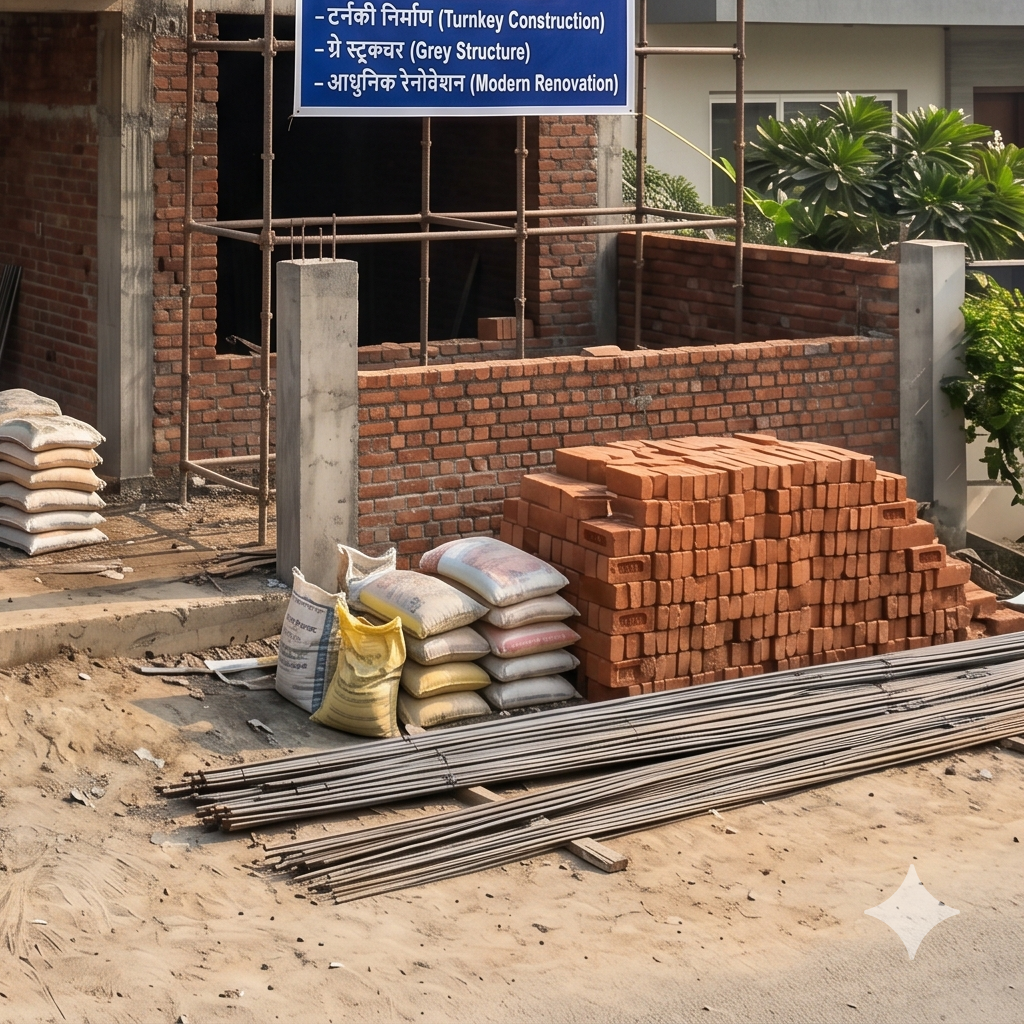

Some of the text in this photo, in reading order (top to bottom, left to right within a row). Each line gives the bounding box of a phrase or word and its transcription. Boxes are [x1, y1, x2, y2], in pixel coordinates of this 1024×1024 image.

[326, 0, 377, 26] टर्नकी
[380, 2, 434, 27] निर्माण
[438, 8, 503, 33] (Turnkey
[508, 10, 605, 34] Construction)
[326, 33, 342, 58] ग्रे
[410, 40, 452, 64] (Grey
[456, 41, 531, 65] Structure)
[327, 67, 397, 98] आधुनिक
[398, 67, 466, 92] रेनोवेशन
[470, 73, 531, 97] (Modern
[535, 73, 619, 97] Renovation)
